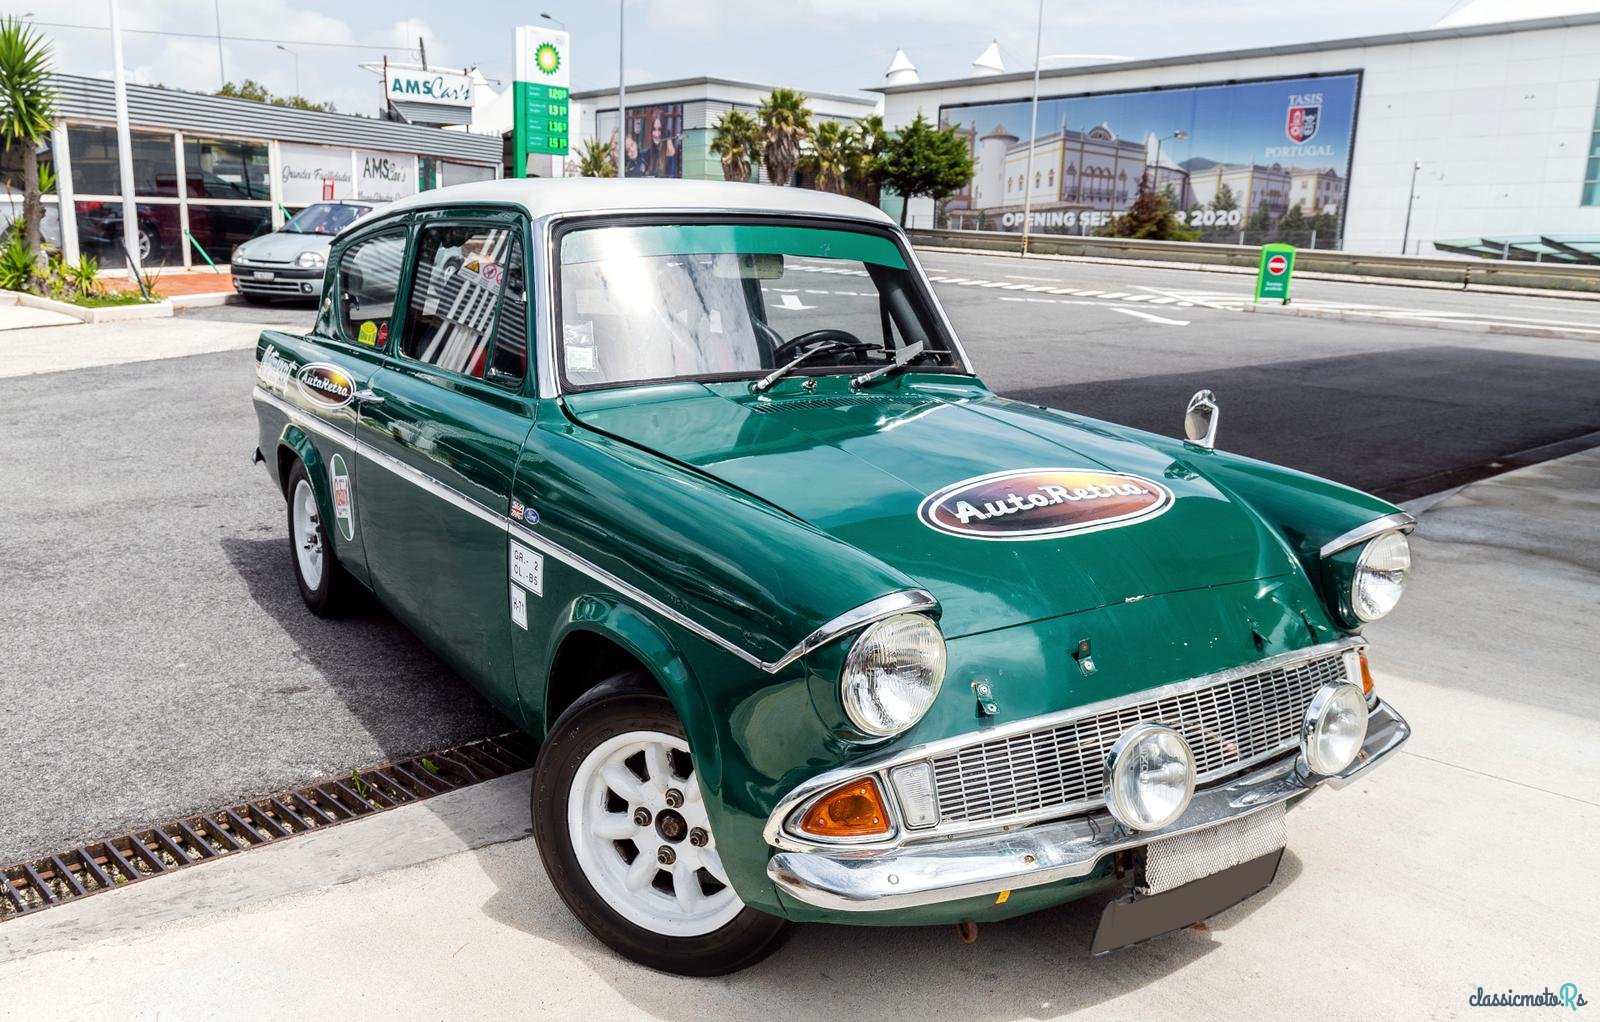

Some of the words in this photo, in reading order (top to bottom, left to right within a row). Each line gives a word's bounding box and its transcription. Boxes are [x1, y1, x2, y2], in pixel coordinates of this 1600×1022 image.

[1287, 93, 1324, 106] TASIS
[1264, 145, 1335, 158] PORTUGAL
[1002, 211, 1076, 227] OPENING
[1190, 209, 1241, 227] 2020
[955, 483, 1149, 524] AutoRetro
